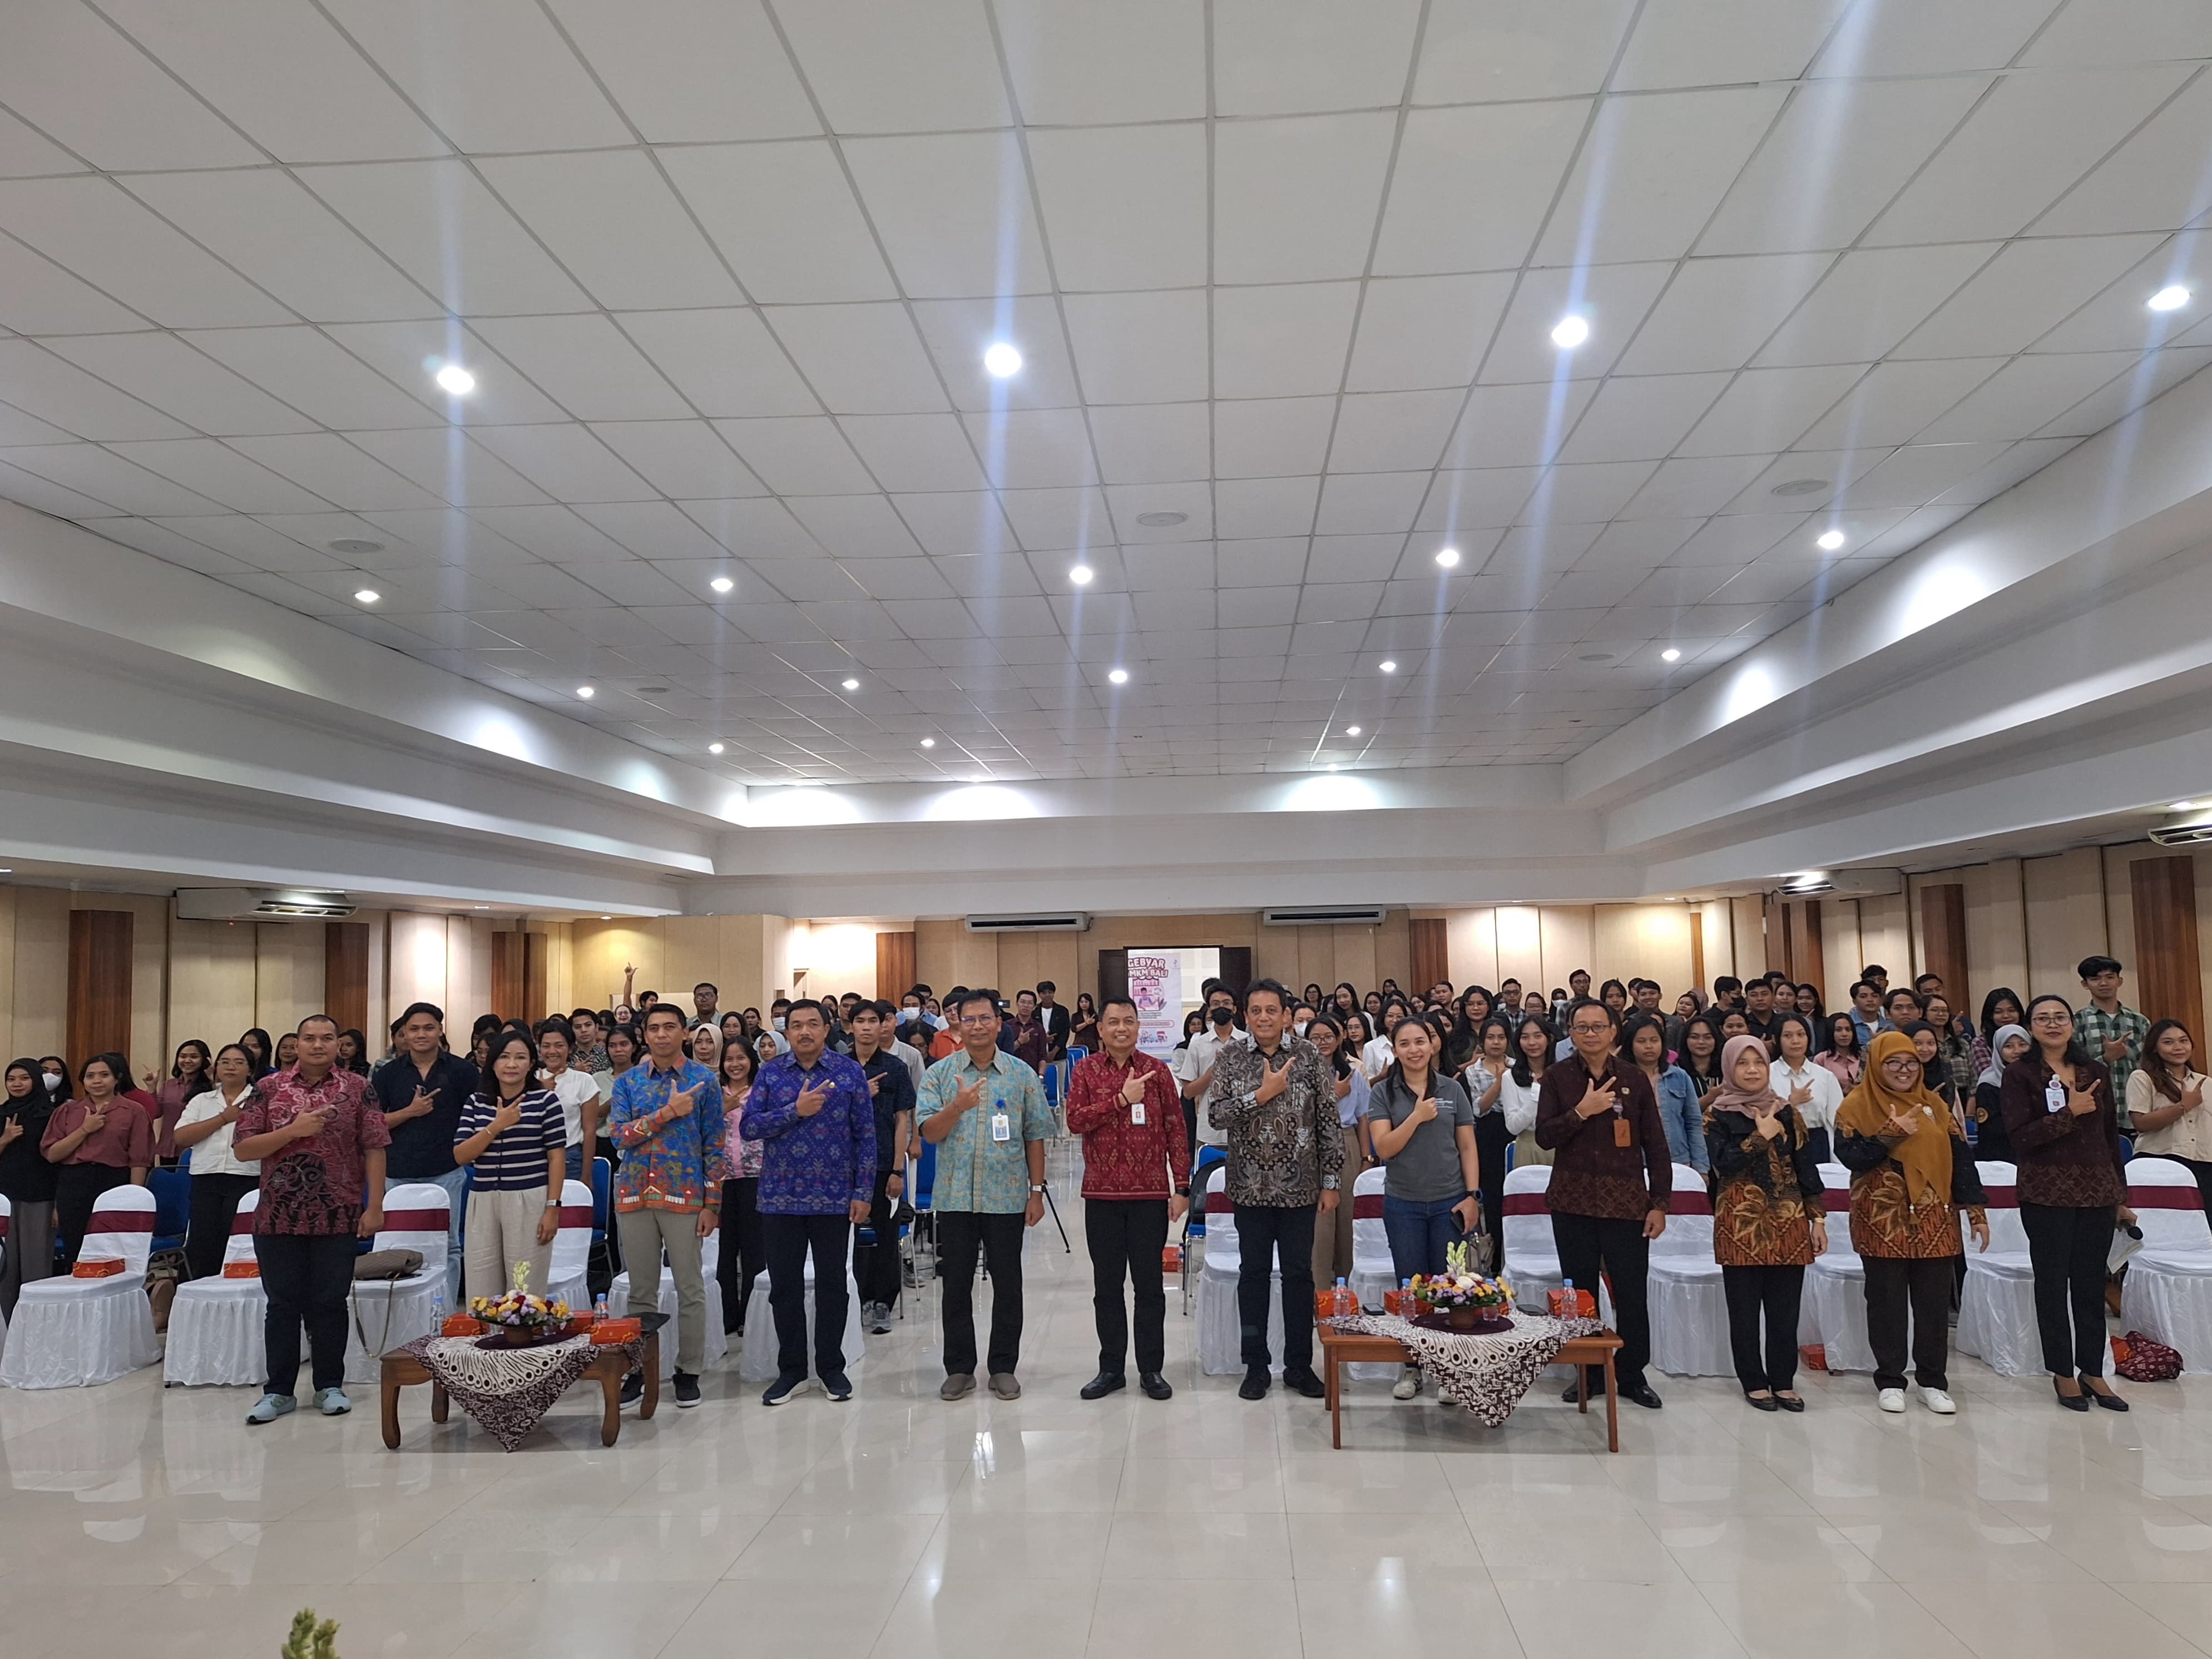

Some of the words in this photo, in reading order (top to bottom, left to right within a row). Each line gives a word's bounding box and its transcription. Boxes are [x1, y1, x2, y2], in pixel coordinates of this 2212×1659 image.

[1128, 957, 1165, 968] GEBYAR
[1128, 969, 1149, 977] MKM
[1150, 969, 1168, 978] BALI
